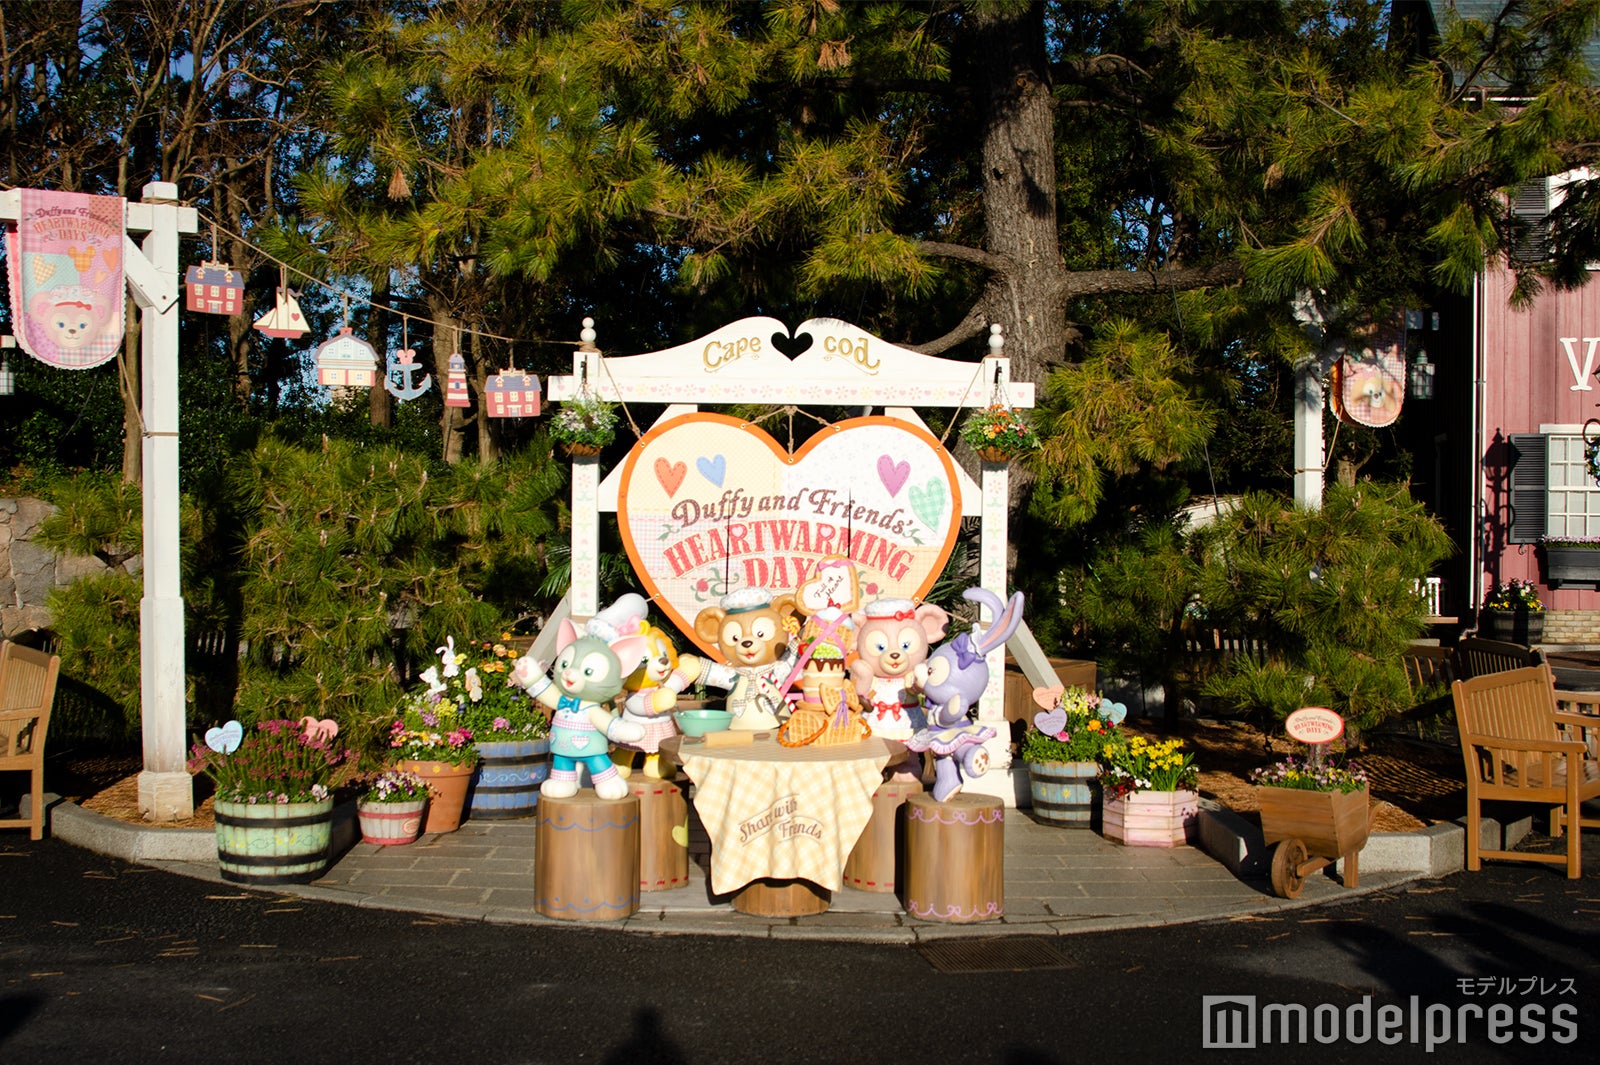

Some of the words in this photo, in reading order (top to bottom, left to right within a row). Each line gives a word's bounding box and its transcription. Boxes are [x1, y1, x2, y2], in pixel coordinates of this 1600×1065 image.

[33, 217, 110, 239] HEARTWARMING
[58, 229, 87, 241] DAYS
[703, 336, 762, 369] Cape
[671, 488, 754, 528] Duffy
[758, 487, 809, 511] and
[808, 488, 913, 534] Friends'
[663, 519, 915, 582] HEARTWARMING
[742, 556, 815, 590] DAY
